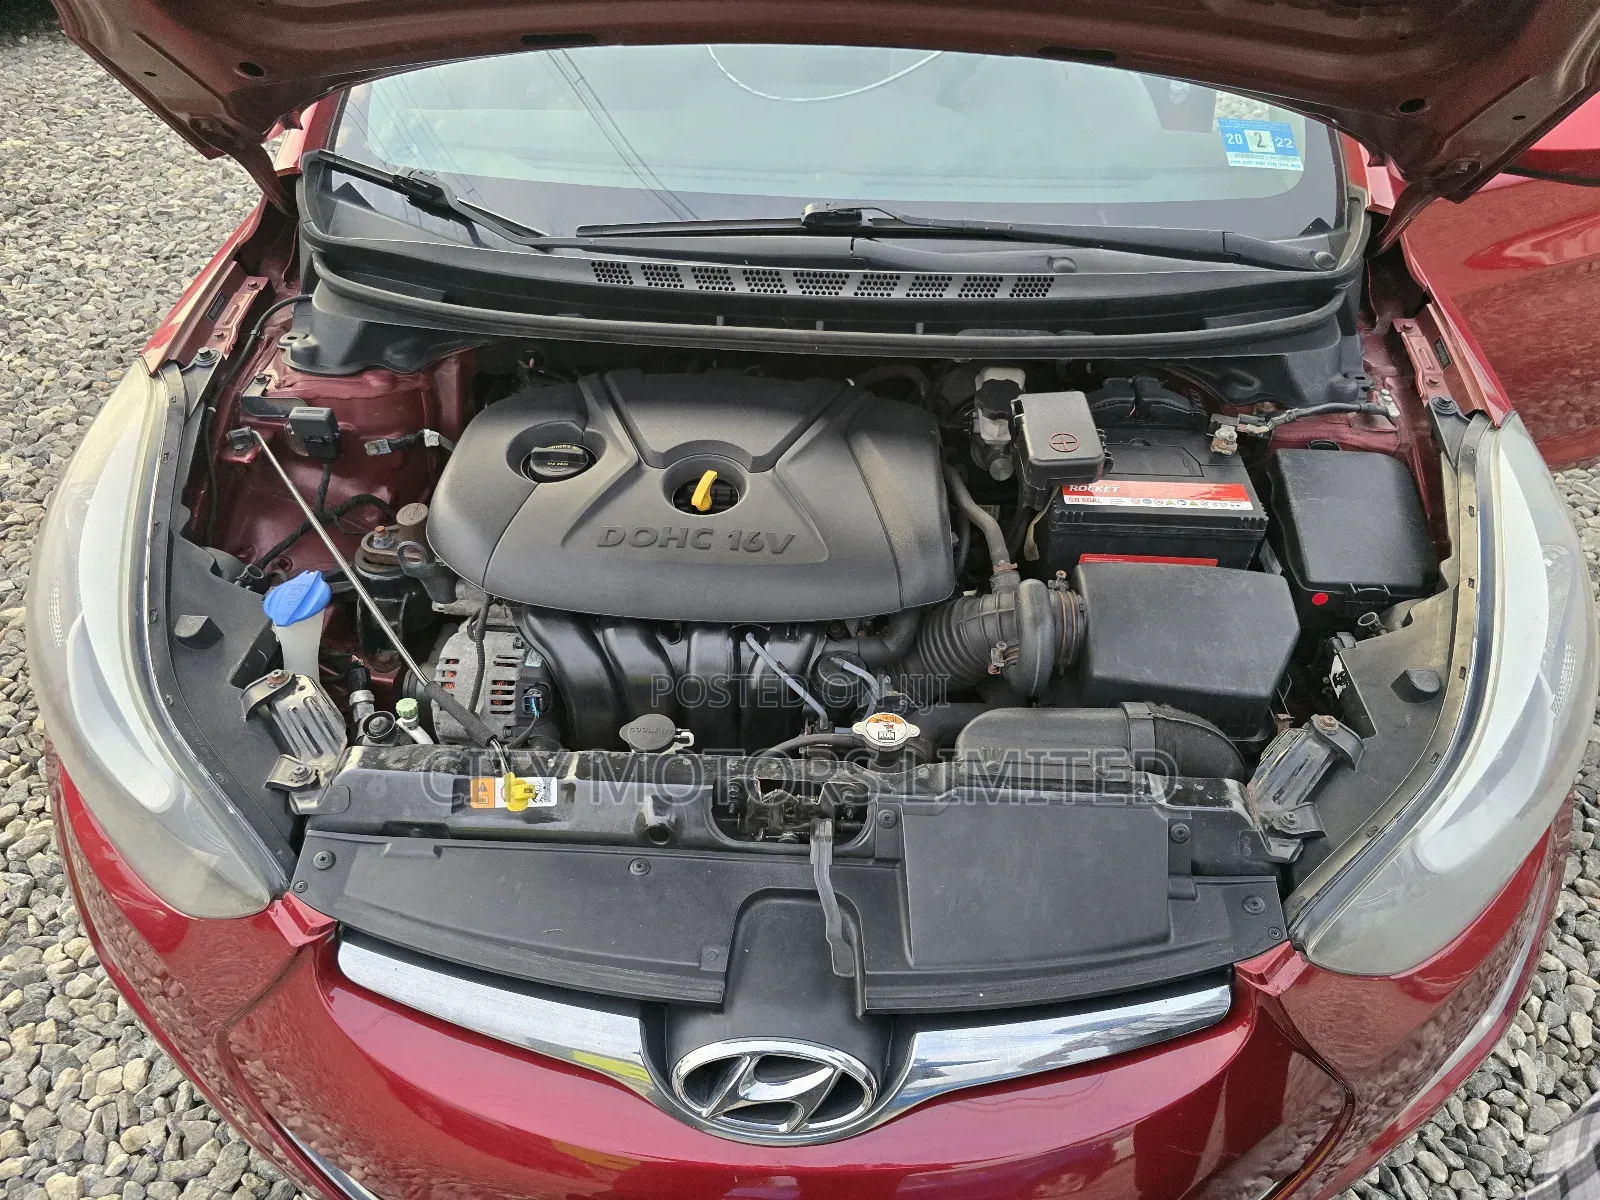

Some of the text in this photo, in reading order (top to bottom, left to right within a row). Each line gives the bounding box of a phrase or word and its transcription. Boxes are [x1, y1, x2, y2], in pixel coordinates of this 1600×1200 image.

[1225, 131, 1294, 149] 20 2 22
[1068, 484, 1120, 493] ROCKET
[597, 526, 796, 555] DOHC 16V
[629, 727, 675, 735] COOLANT
